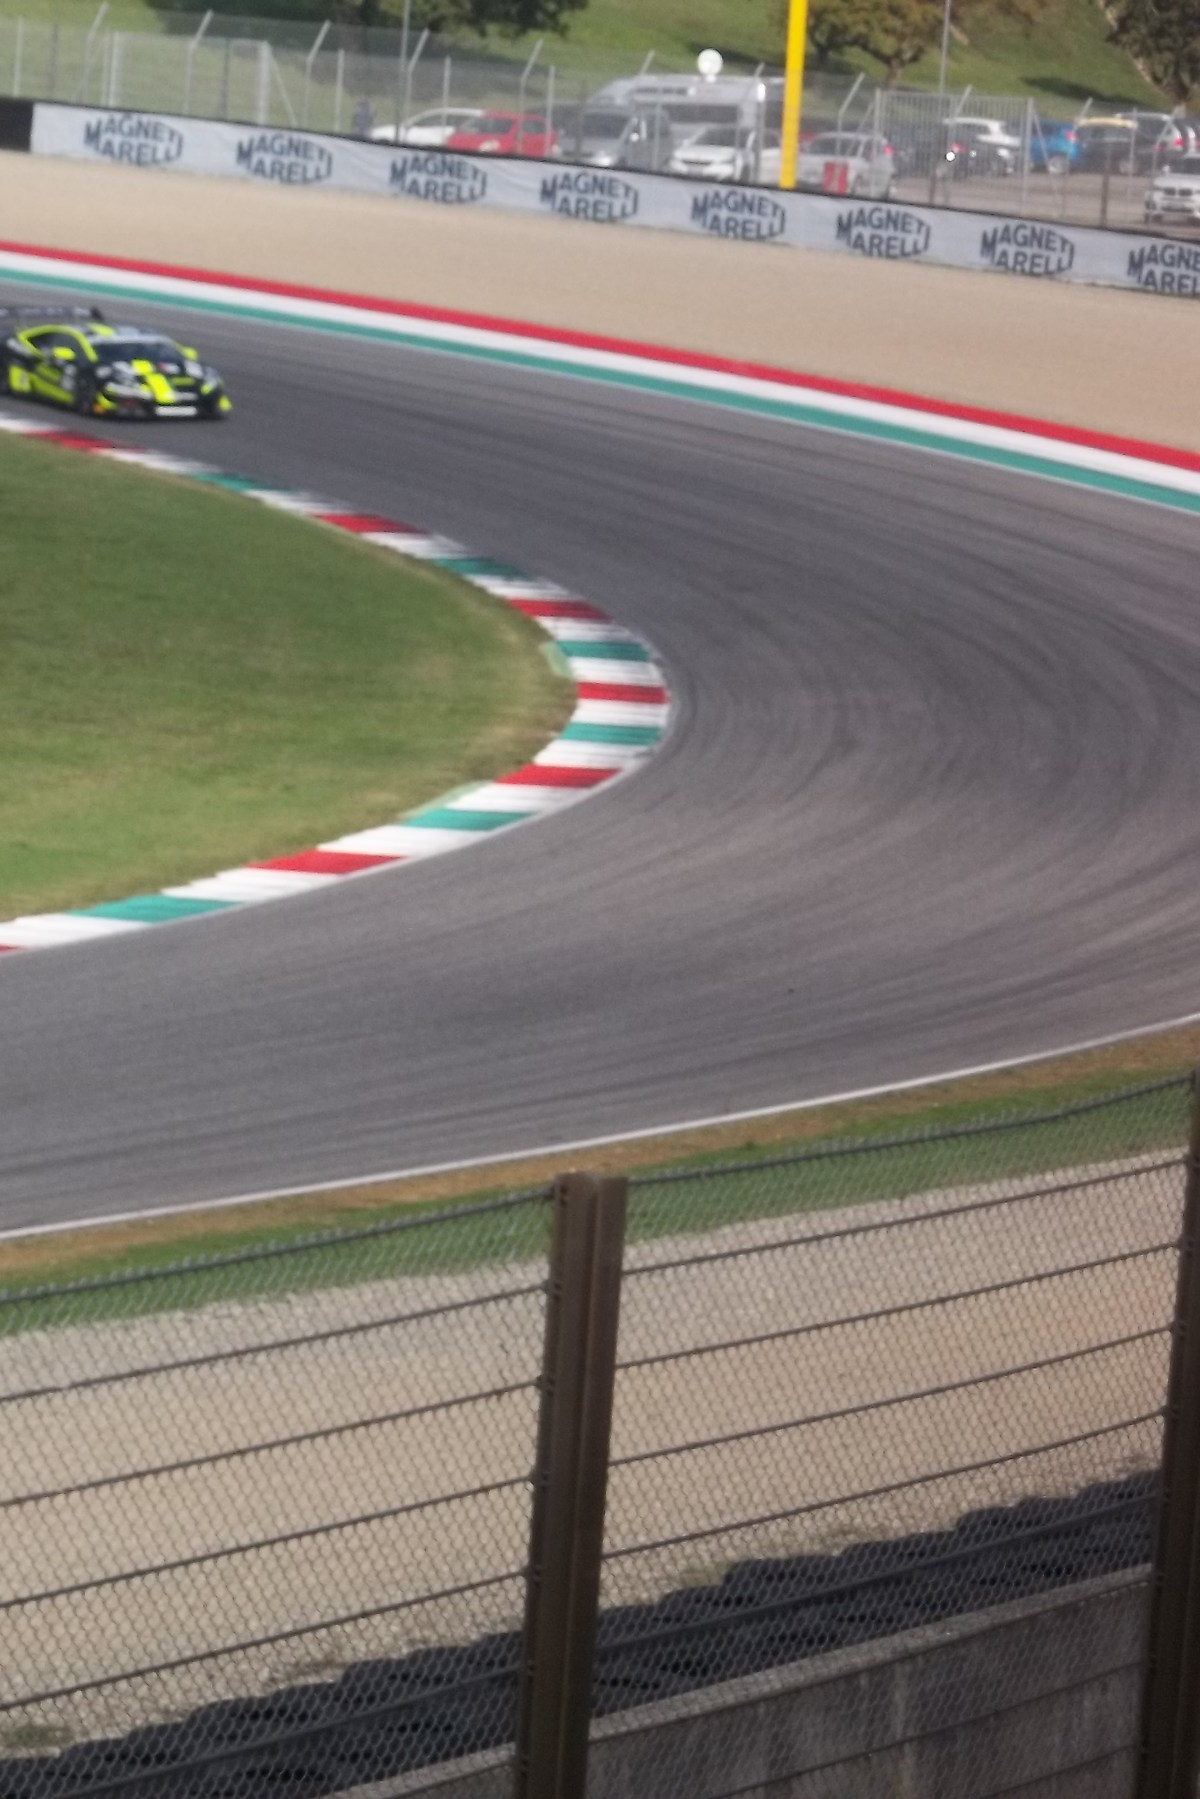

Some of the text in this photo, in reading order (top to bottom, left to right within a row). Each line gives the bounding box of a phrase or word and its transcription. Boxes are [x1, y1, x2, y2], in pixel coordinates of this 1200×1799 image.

[84, 113, 184, 149] MAGNETI
[84, 136, 184, 166] MARELLI
[236, 133, 333, 164] MAGNETI
[236, 155, 333, 184] MARELLI
[389, 153, 488, 187] MAGNETI
[389, 176, 488, 205] MARELLI
[540, 171, 639, 204] MAGNETI
[540, 194, 639, 222] MARELLI
[690, 189, 786, 223] MAGNETI
[690, 212, 786, 241] MARELLI
[835, 206, 931, 239] MAGNETI
[835, 229, 931, 258] MARELLI
[980, 224, 1076, 256] MAGNETI
[980, 248, 1076, 275] MARELLI
